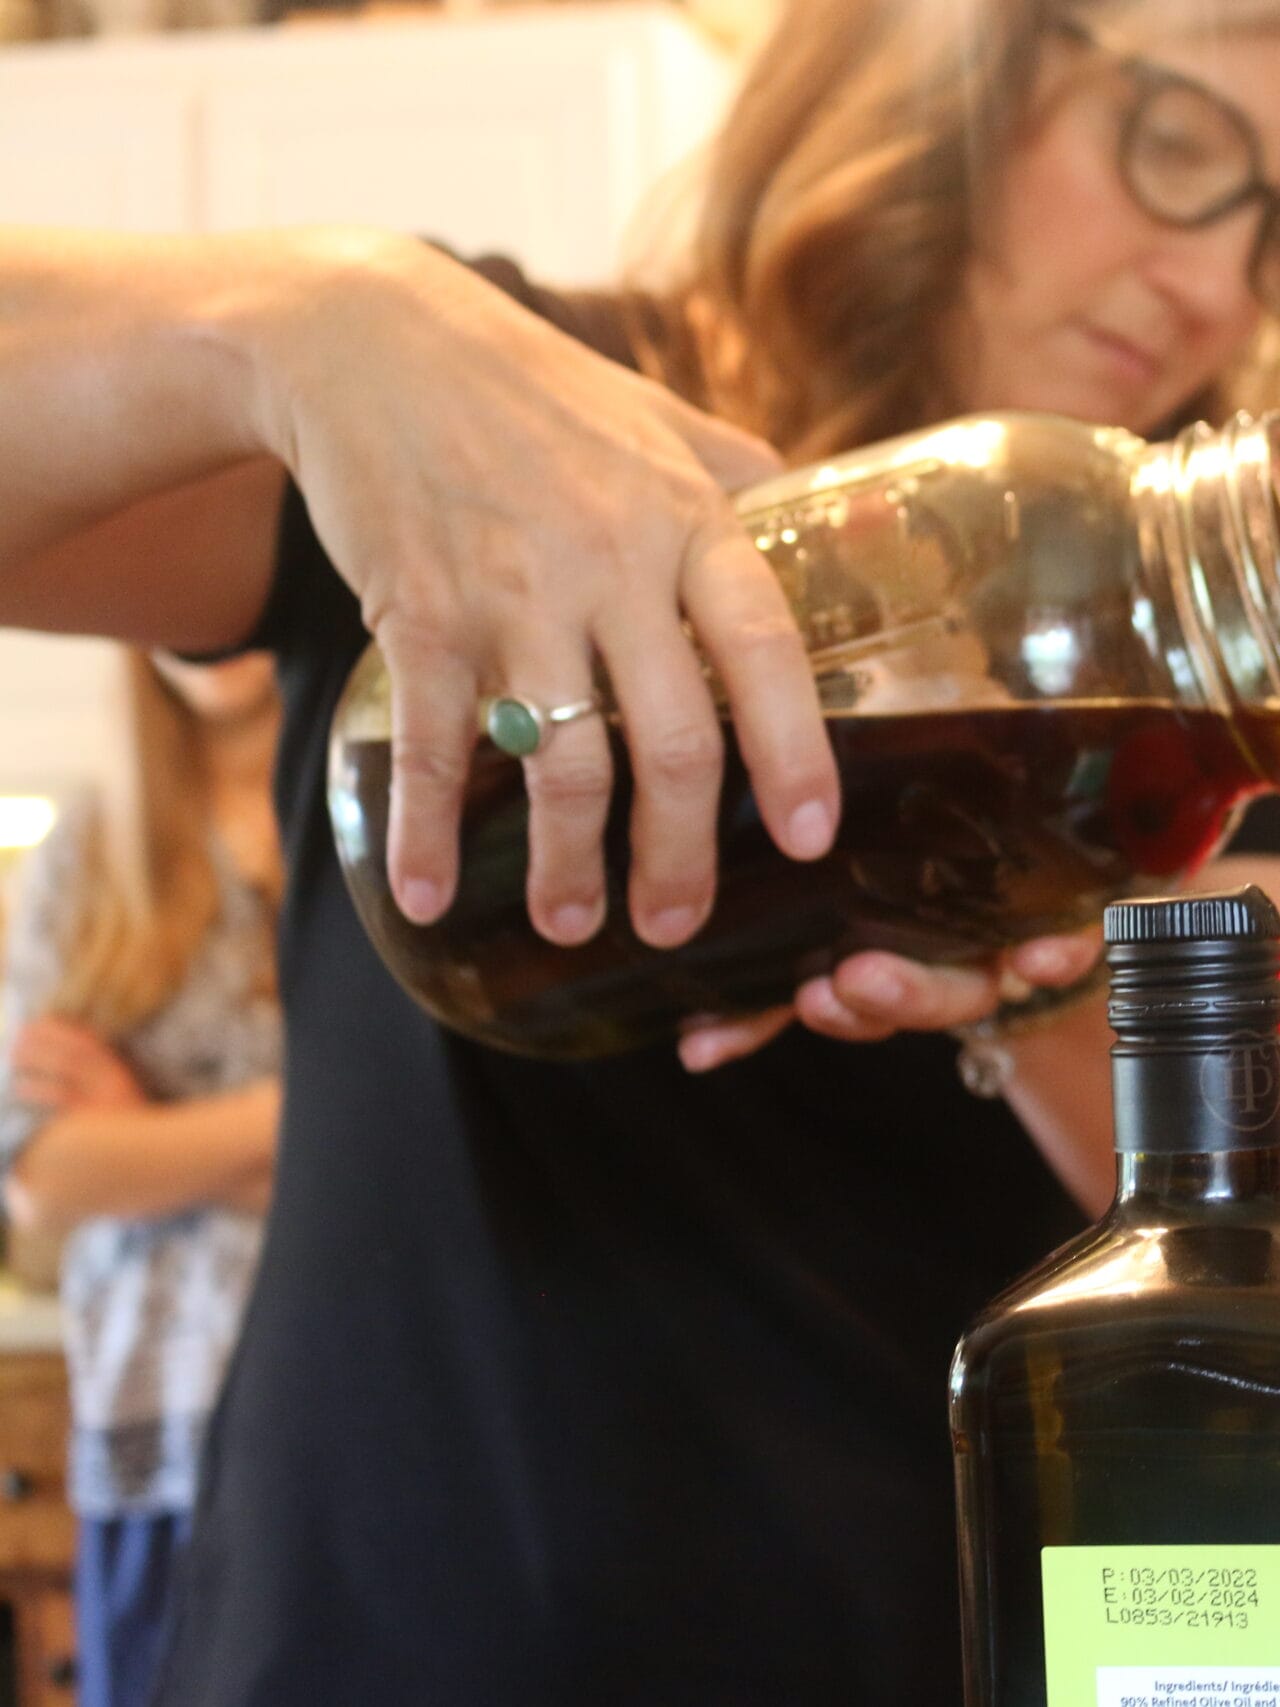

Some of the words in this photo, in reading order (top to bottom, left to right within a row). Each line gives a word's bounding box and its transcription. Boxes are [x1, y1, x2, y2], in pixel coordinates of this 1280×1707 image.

[1120, 1696, 1149, 1707] 90%
[1151, 1696, 1197, 1707] Refined
[1199, 1696, 1231, 1707] Olive
[1233, 1696, 1252, 1707] Oil
[1254, 1697, 1277, 1707] and
